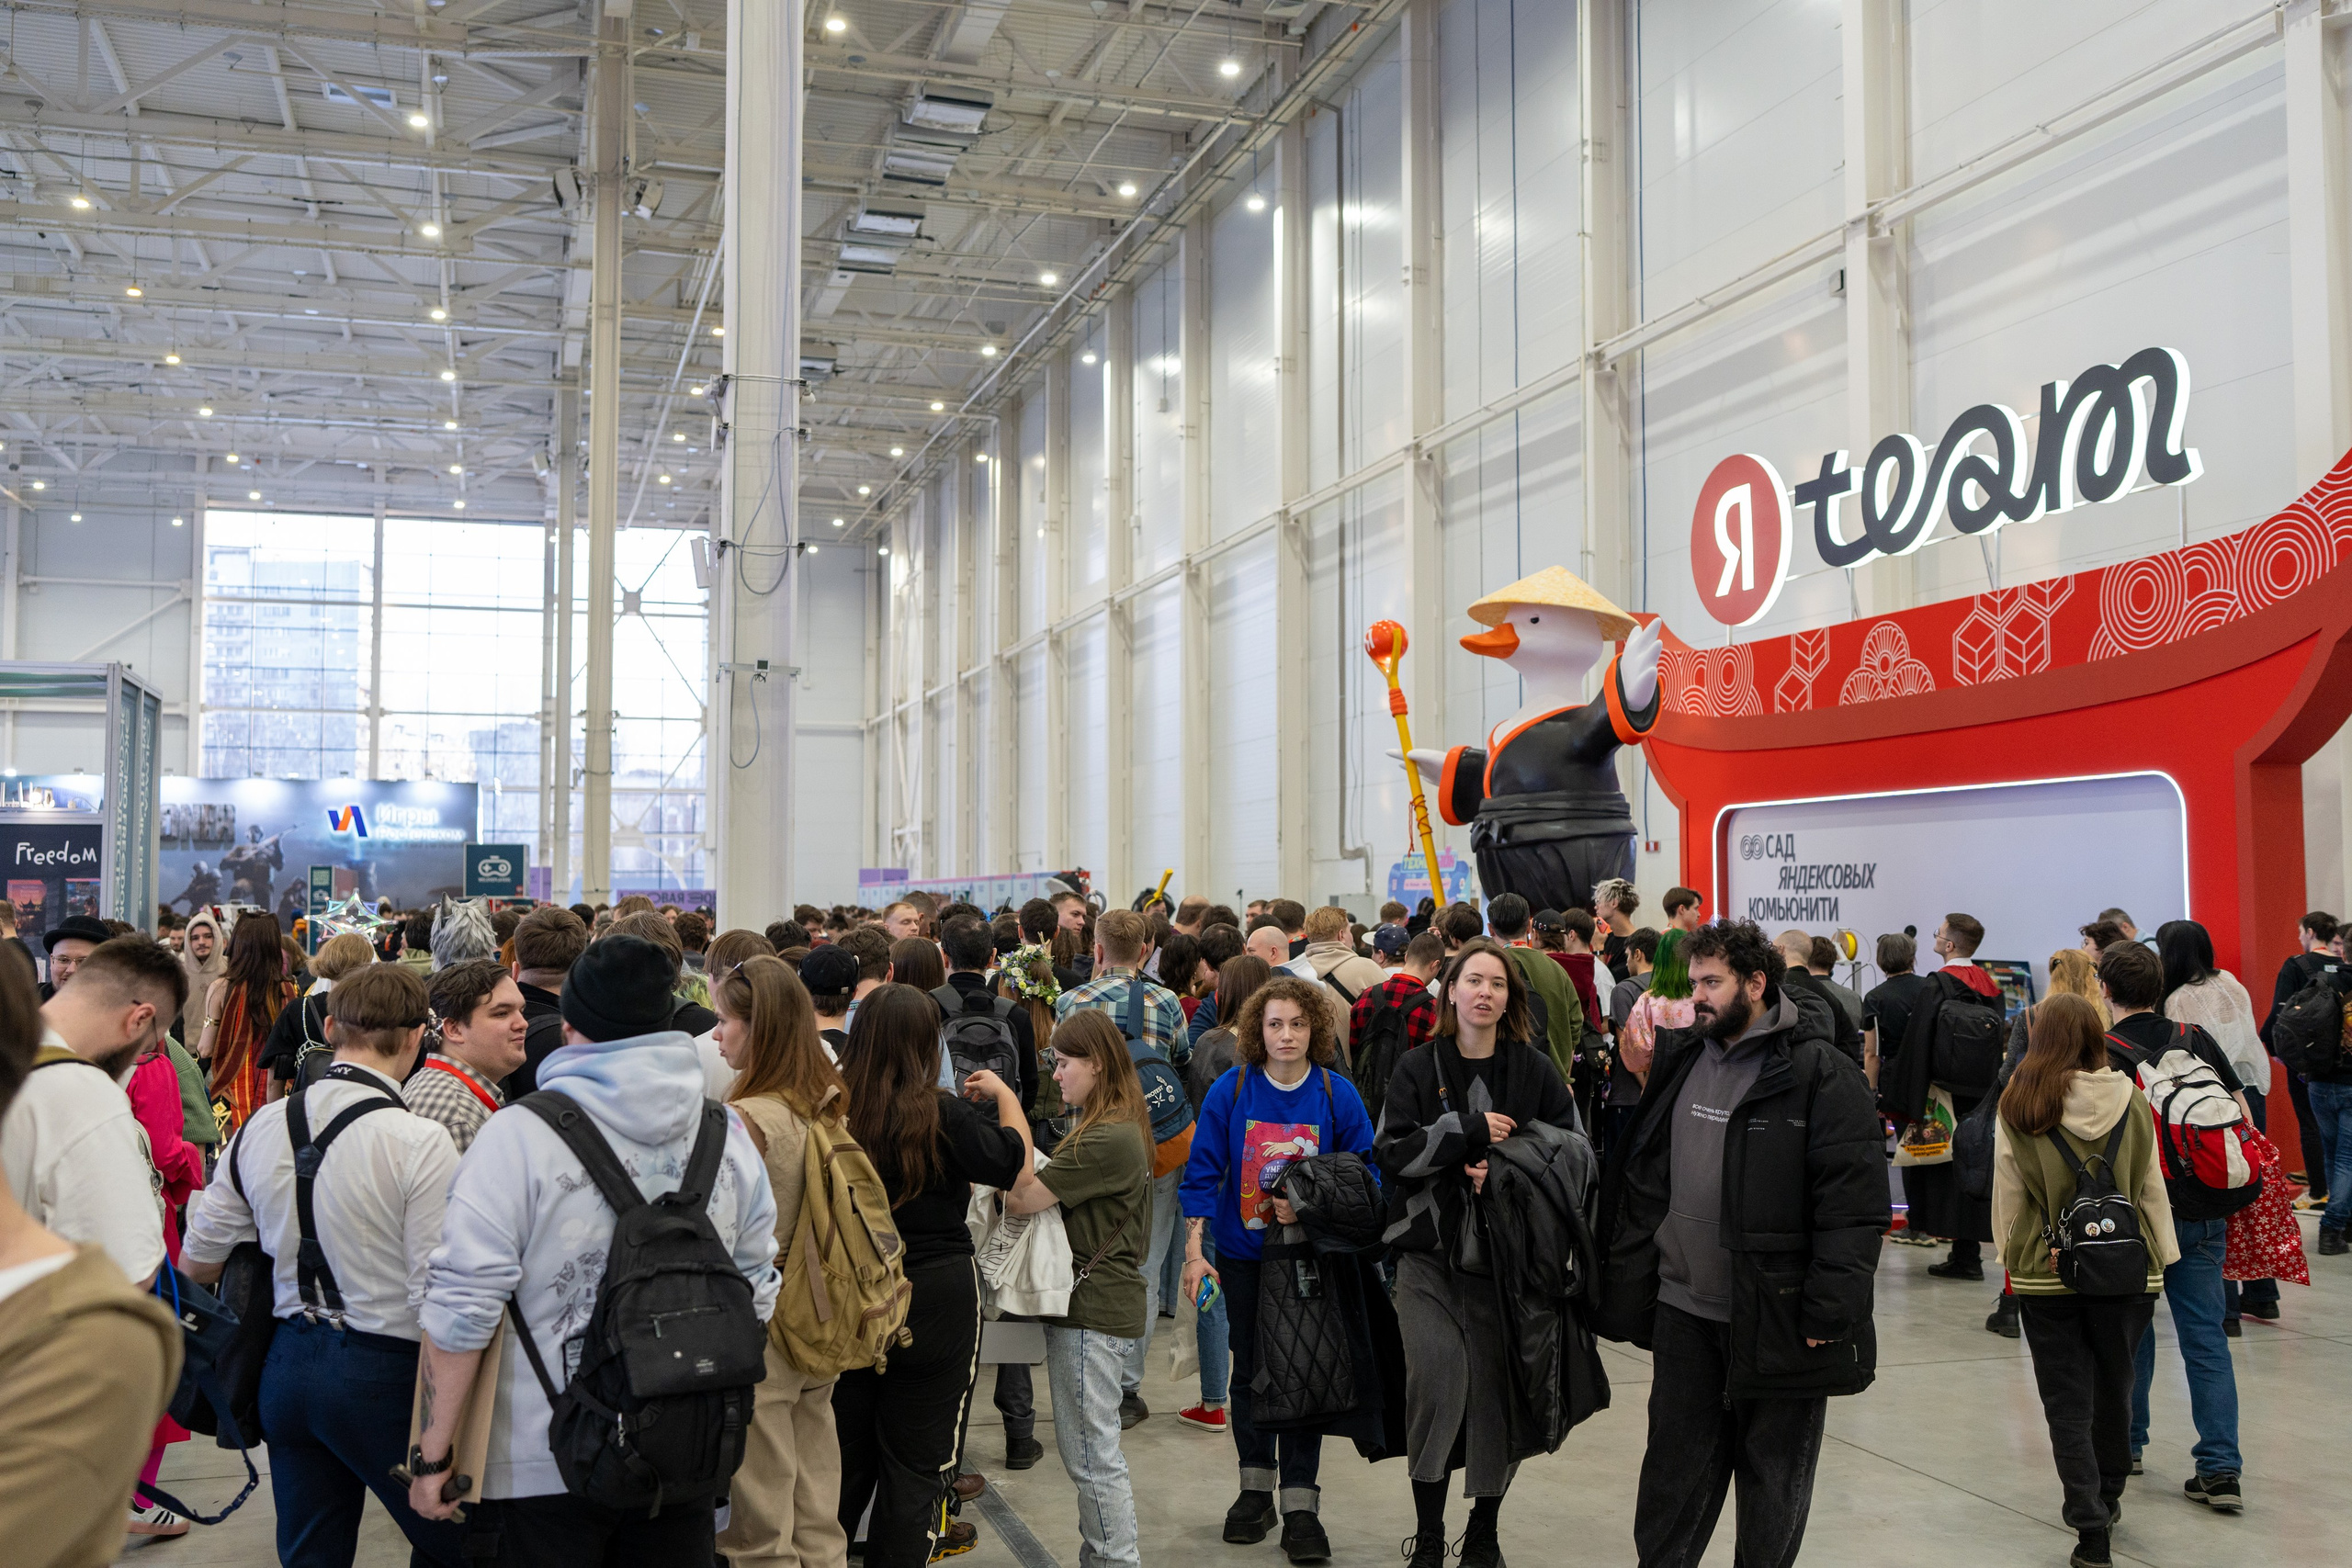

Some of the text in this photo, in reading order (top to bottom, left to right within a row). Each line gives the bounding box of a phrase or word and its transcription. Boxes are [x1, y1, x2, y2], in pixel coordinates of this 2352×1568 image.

[1794, 347, 2199, 568] team
[377, 805, 437, 827] Игры
[1766, 834, 1795, 862] САД
[1778, 863, 1877, 894] ЯНДЕКСОВЫХ
[1748, 897, 1839, 922] КОМЬЮНИТИ
[1144, 1085, 1164, 1100] PROTEST
